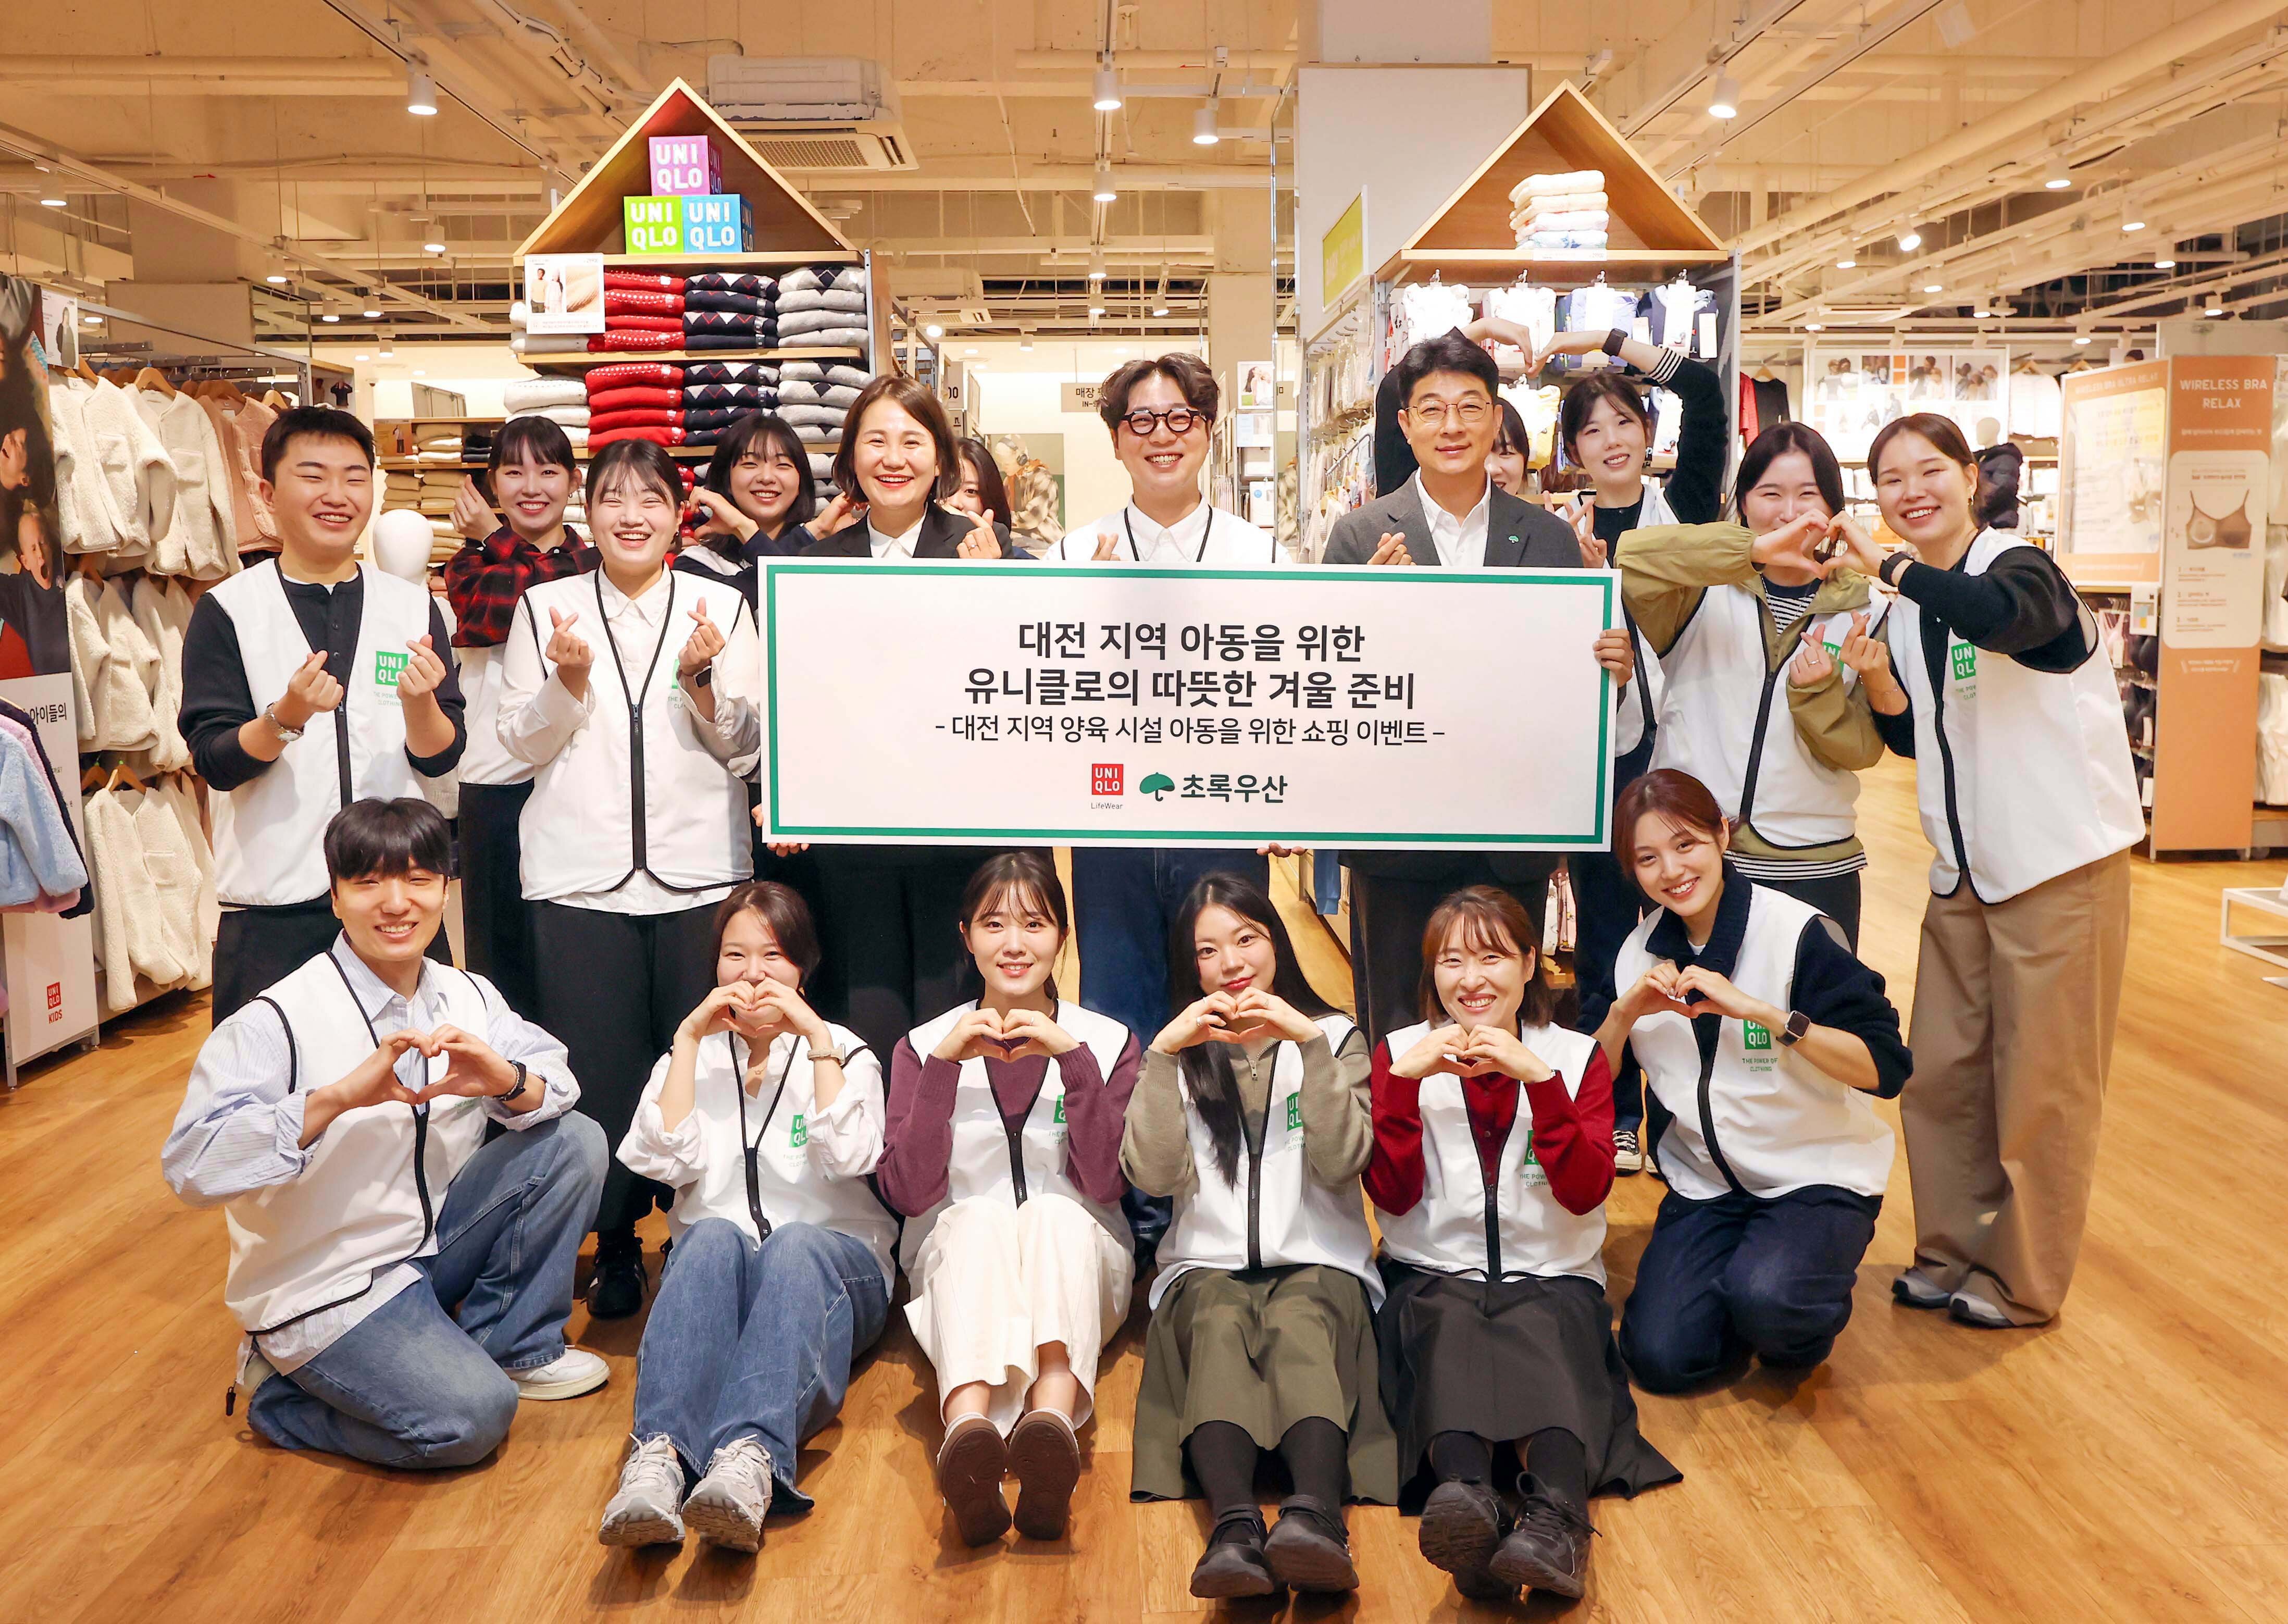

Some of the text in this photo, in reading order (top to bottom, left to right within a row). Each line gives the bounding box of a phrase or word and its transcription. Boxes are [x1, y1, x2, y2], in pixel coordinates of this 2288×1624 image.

[655, 144, 698, 165] UNI
[709, 145, 720, 170] UNI
[657, 168, 702, 192] QLO
[710, 170, 722, 194] QLO
[630, 202, 672, 223] UNI
[689, 202, 730, 223] UNI
[741, 204, 751, 228] UNI
[632, 226, 677, 250] QLO
[690, 226, 735, 250] QLO
[742, 228, 753, 252] QLO
[1076, 387, 1095, 398] 매장
[2180, 379, 2268, 391] WIRELESS BRA
[2203, 398, 2242, 409] RELAX
[1019, 621, 1365, 662] 대전 지역 아동을 위한
[379, 655, 402, 669] UNI
[1954, 646, 1973, 661] UN
[965, 668, 1414, 710] 유니클로의 따뜻한 겨울 준비
[30, 702, 67, 725] 아이들의
[952, 715, 999, 741] 대전
[1007, 715, 1053, 743] 지역
[1060, 716, 1110, 743] 양육
[1115, 716, 1162, 744] 시설
[1170, 717, 1242, 745] 아동을
[1248, 718, 1297, 746] 위한
[1301, 718, 1348, 747] 쇼핑
[1357, 720, 1428, 747] 이벤트
[1095, 767, 1118, 779] UNI
[1095, 780, 1120, 794] QLO
[1180, 773, 1289, 804] 초록우산
[48, 985, 58, 996] UNI
[49, 995, 60, 1007] QLO
[48, 1009, 63, 1024] KIDS
[1748, 1032, 1767, 1047] QLO
[1289, 1110, 1302, 1127] QL
